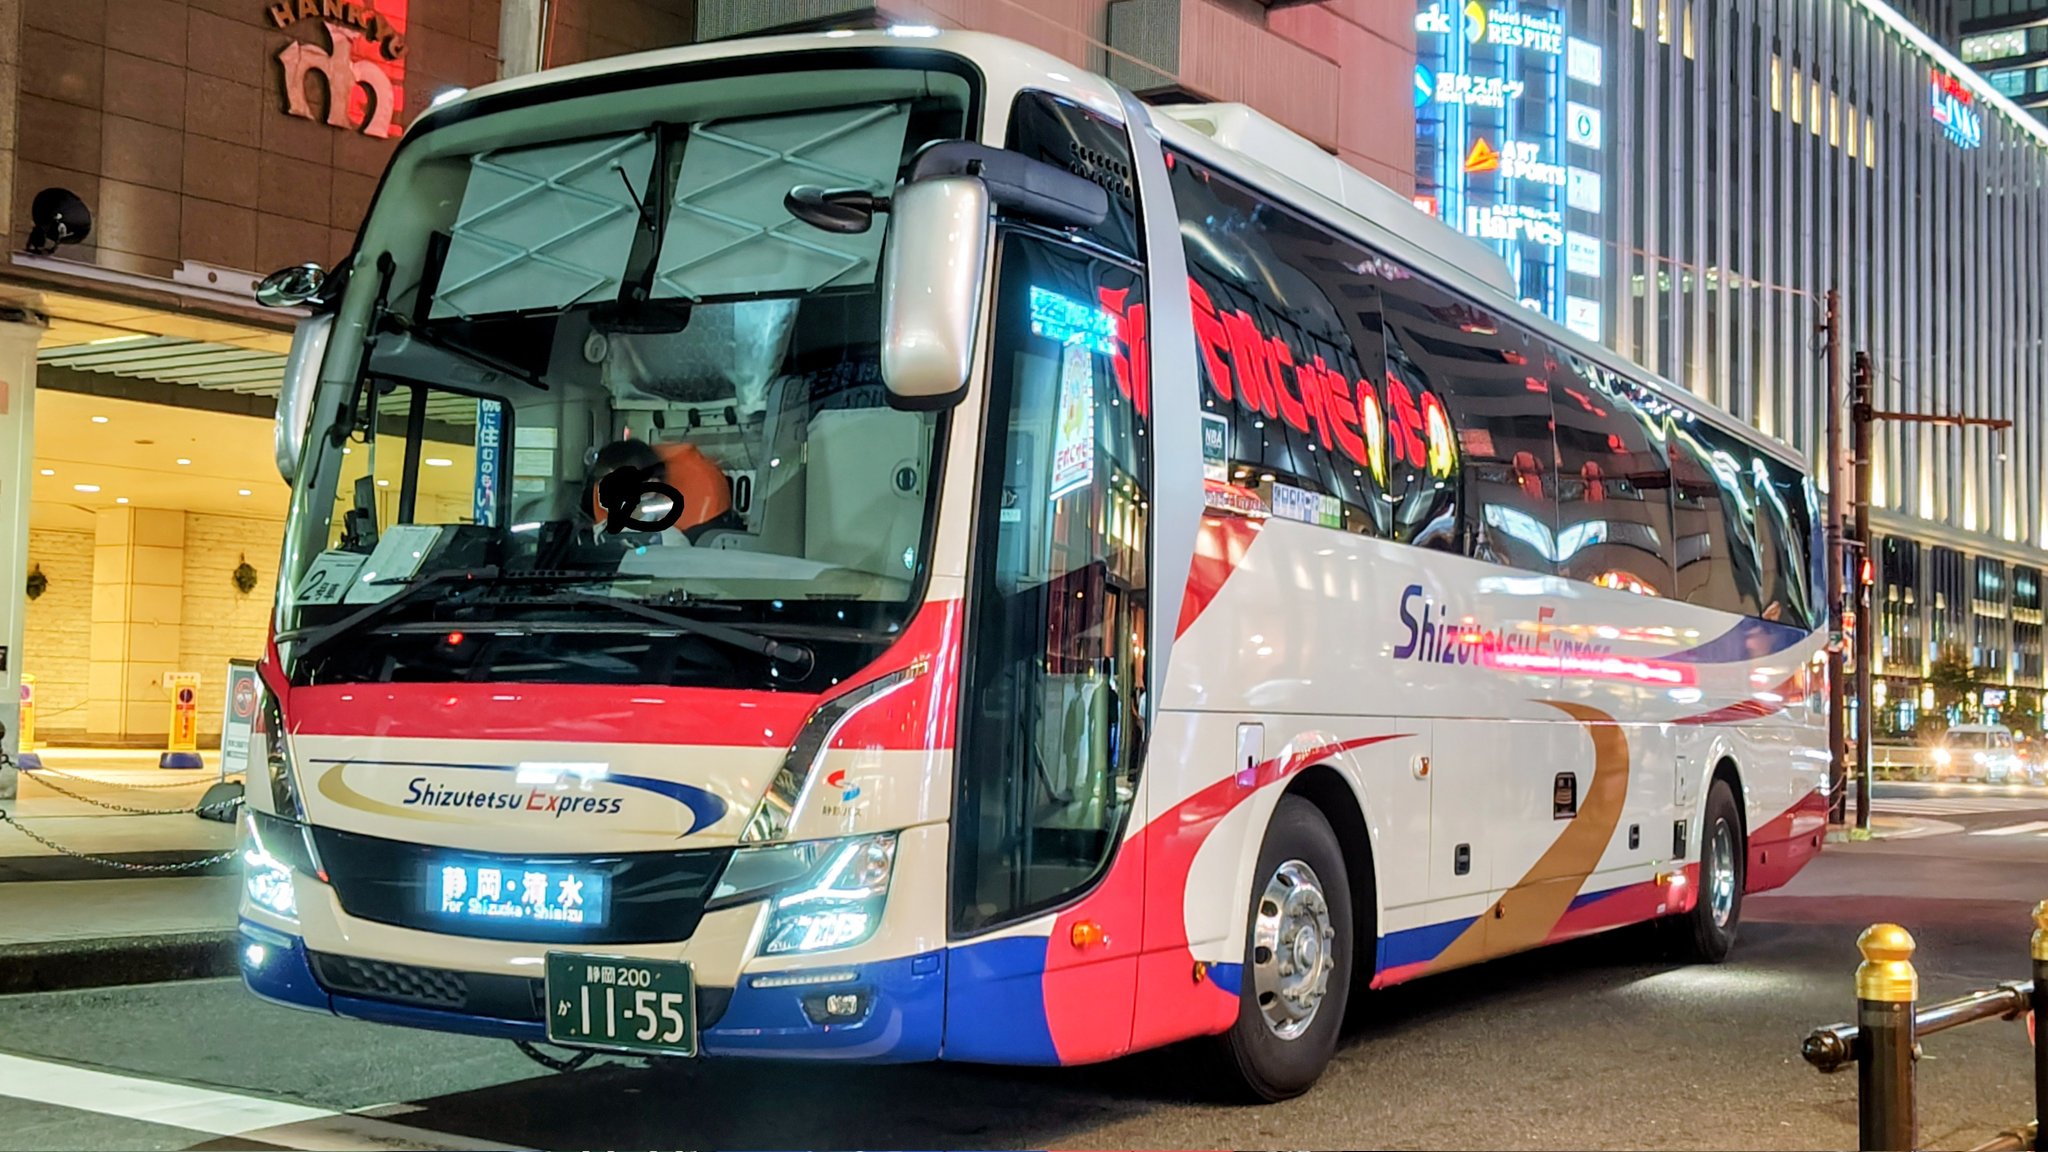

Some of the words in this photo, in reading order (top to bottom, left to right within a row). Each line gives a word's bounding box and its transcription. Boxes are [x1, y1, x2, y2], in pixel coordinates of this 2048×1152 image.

[1489, 9, 1520, 26] Hotel
[1488, 23, 1563, 54] RESPIRE
[1501, 140, 1539, 161] ART
[1500, 158, 1567, 186] SPORTS
[1466, 205, 1564, 246] Harves
[1205, 427, 1223, 448] NBA
[403, 777, 523, 808] Shizutetsu
[526, 788, 623, 818] Express
[442, 900, 464, 912] For
[581, 985, 684, 1043] 11-55
